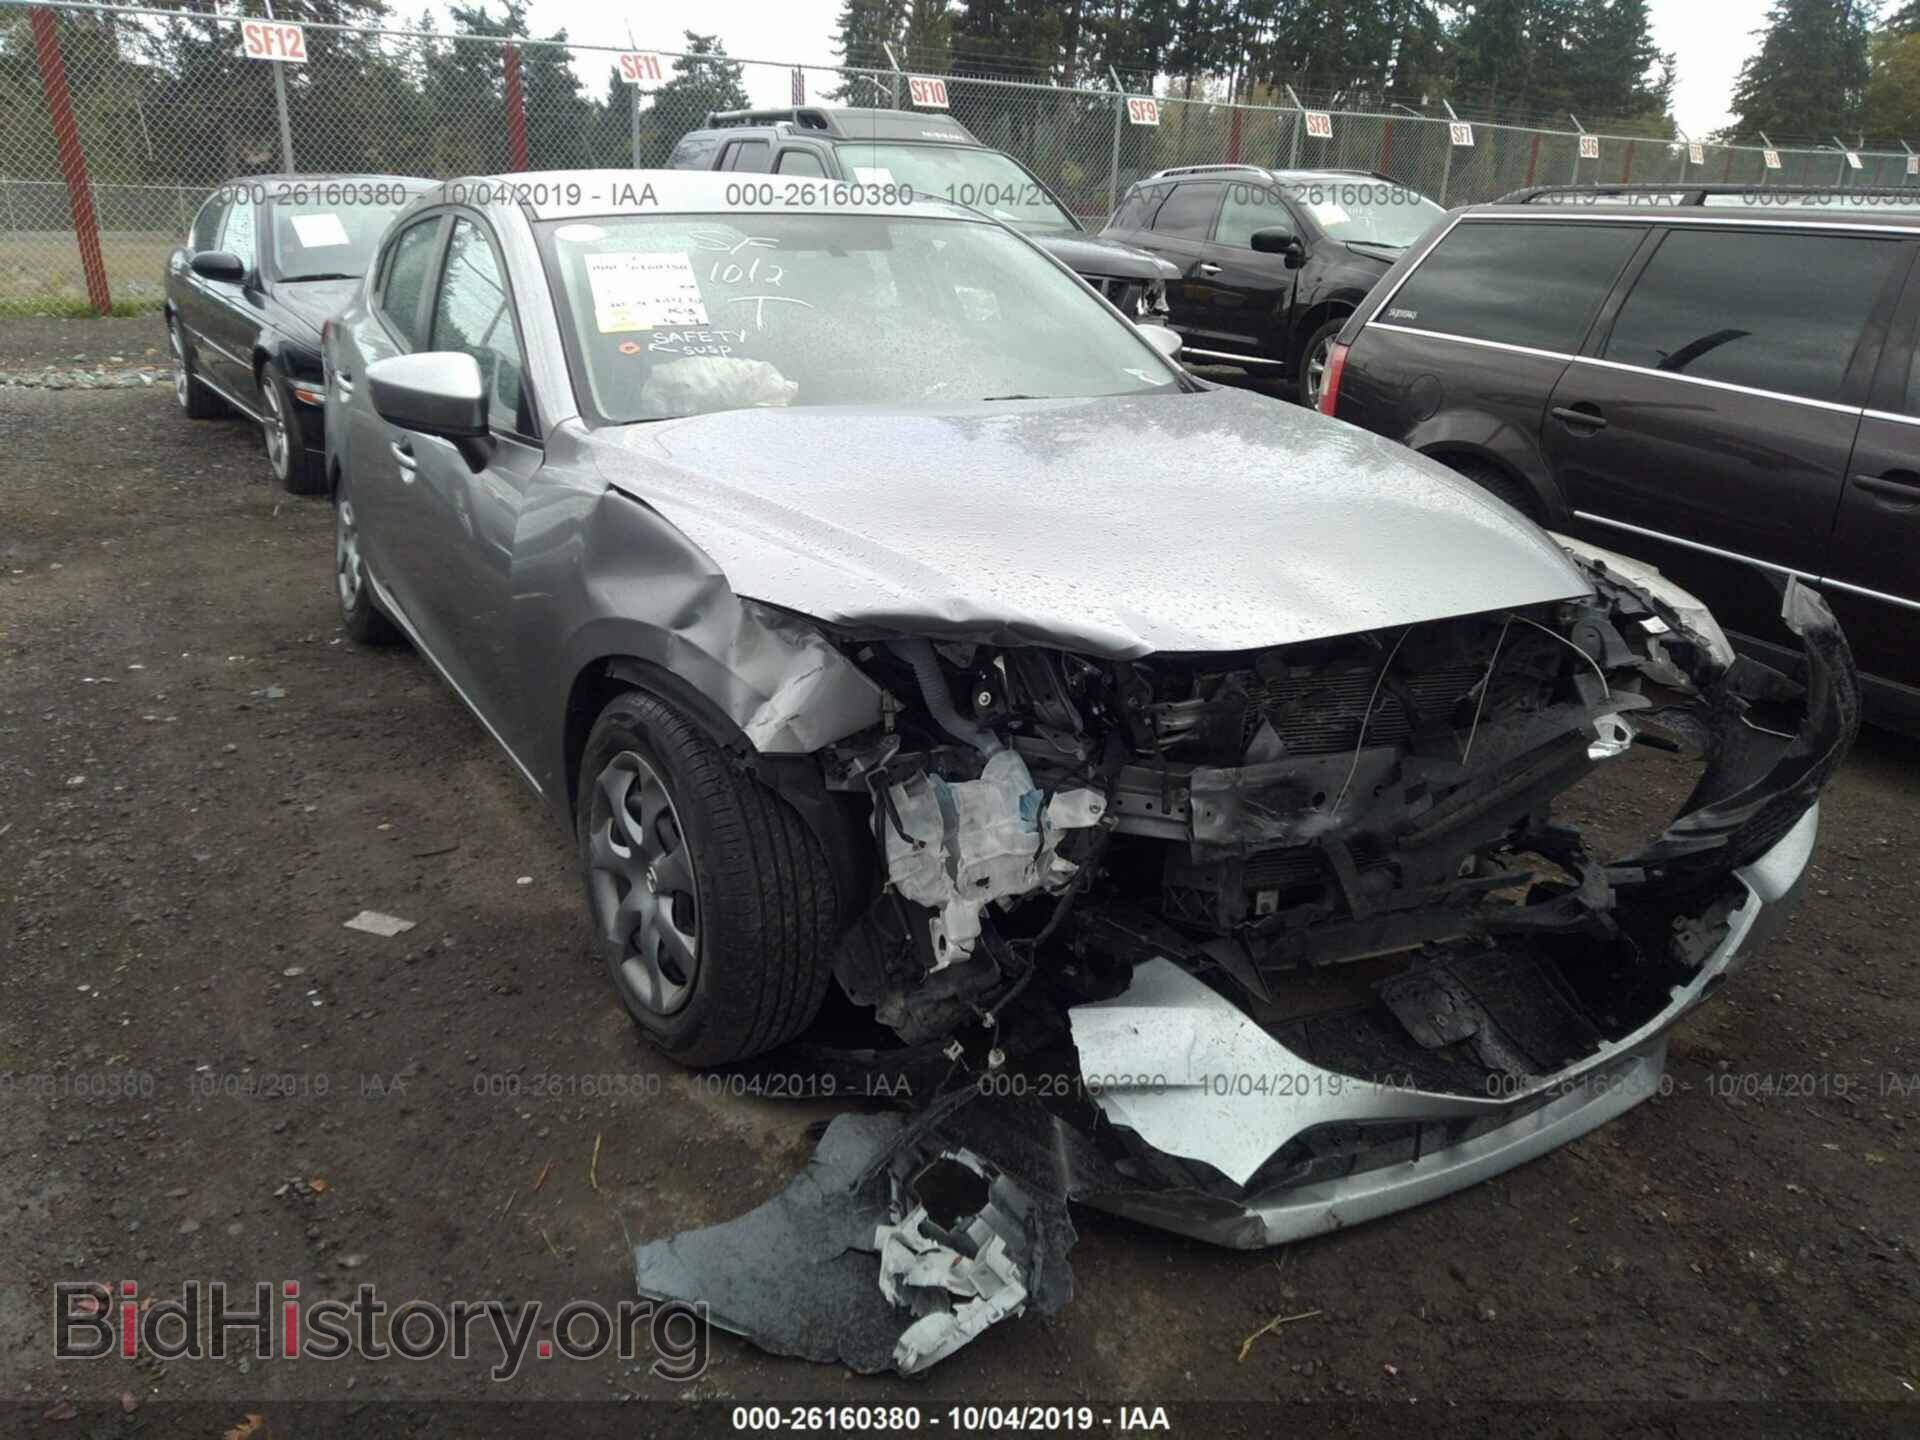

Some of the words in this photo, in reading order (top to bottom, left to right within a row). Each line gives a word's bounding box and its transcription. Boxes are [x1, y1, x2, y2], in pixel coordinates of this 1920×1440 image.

[245, 24, 305, 58] SF12
[620, 54, 662, 80] SF11
[911, 79, 946, 105] SF10
[1130, 100, 1157, 122] SF9
[1307, 113, 1330, 135] SF8
[1452, 125, 1471, 144] SF7
[653, 329, 746, 345] SAFETY
